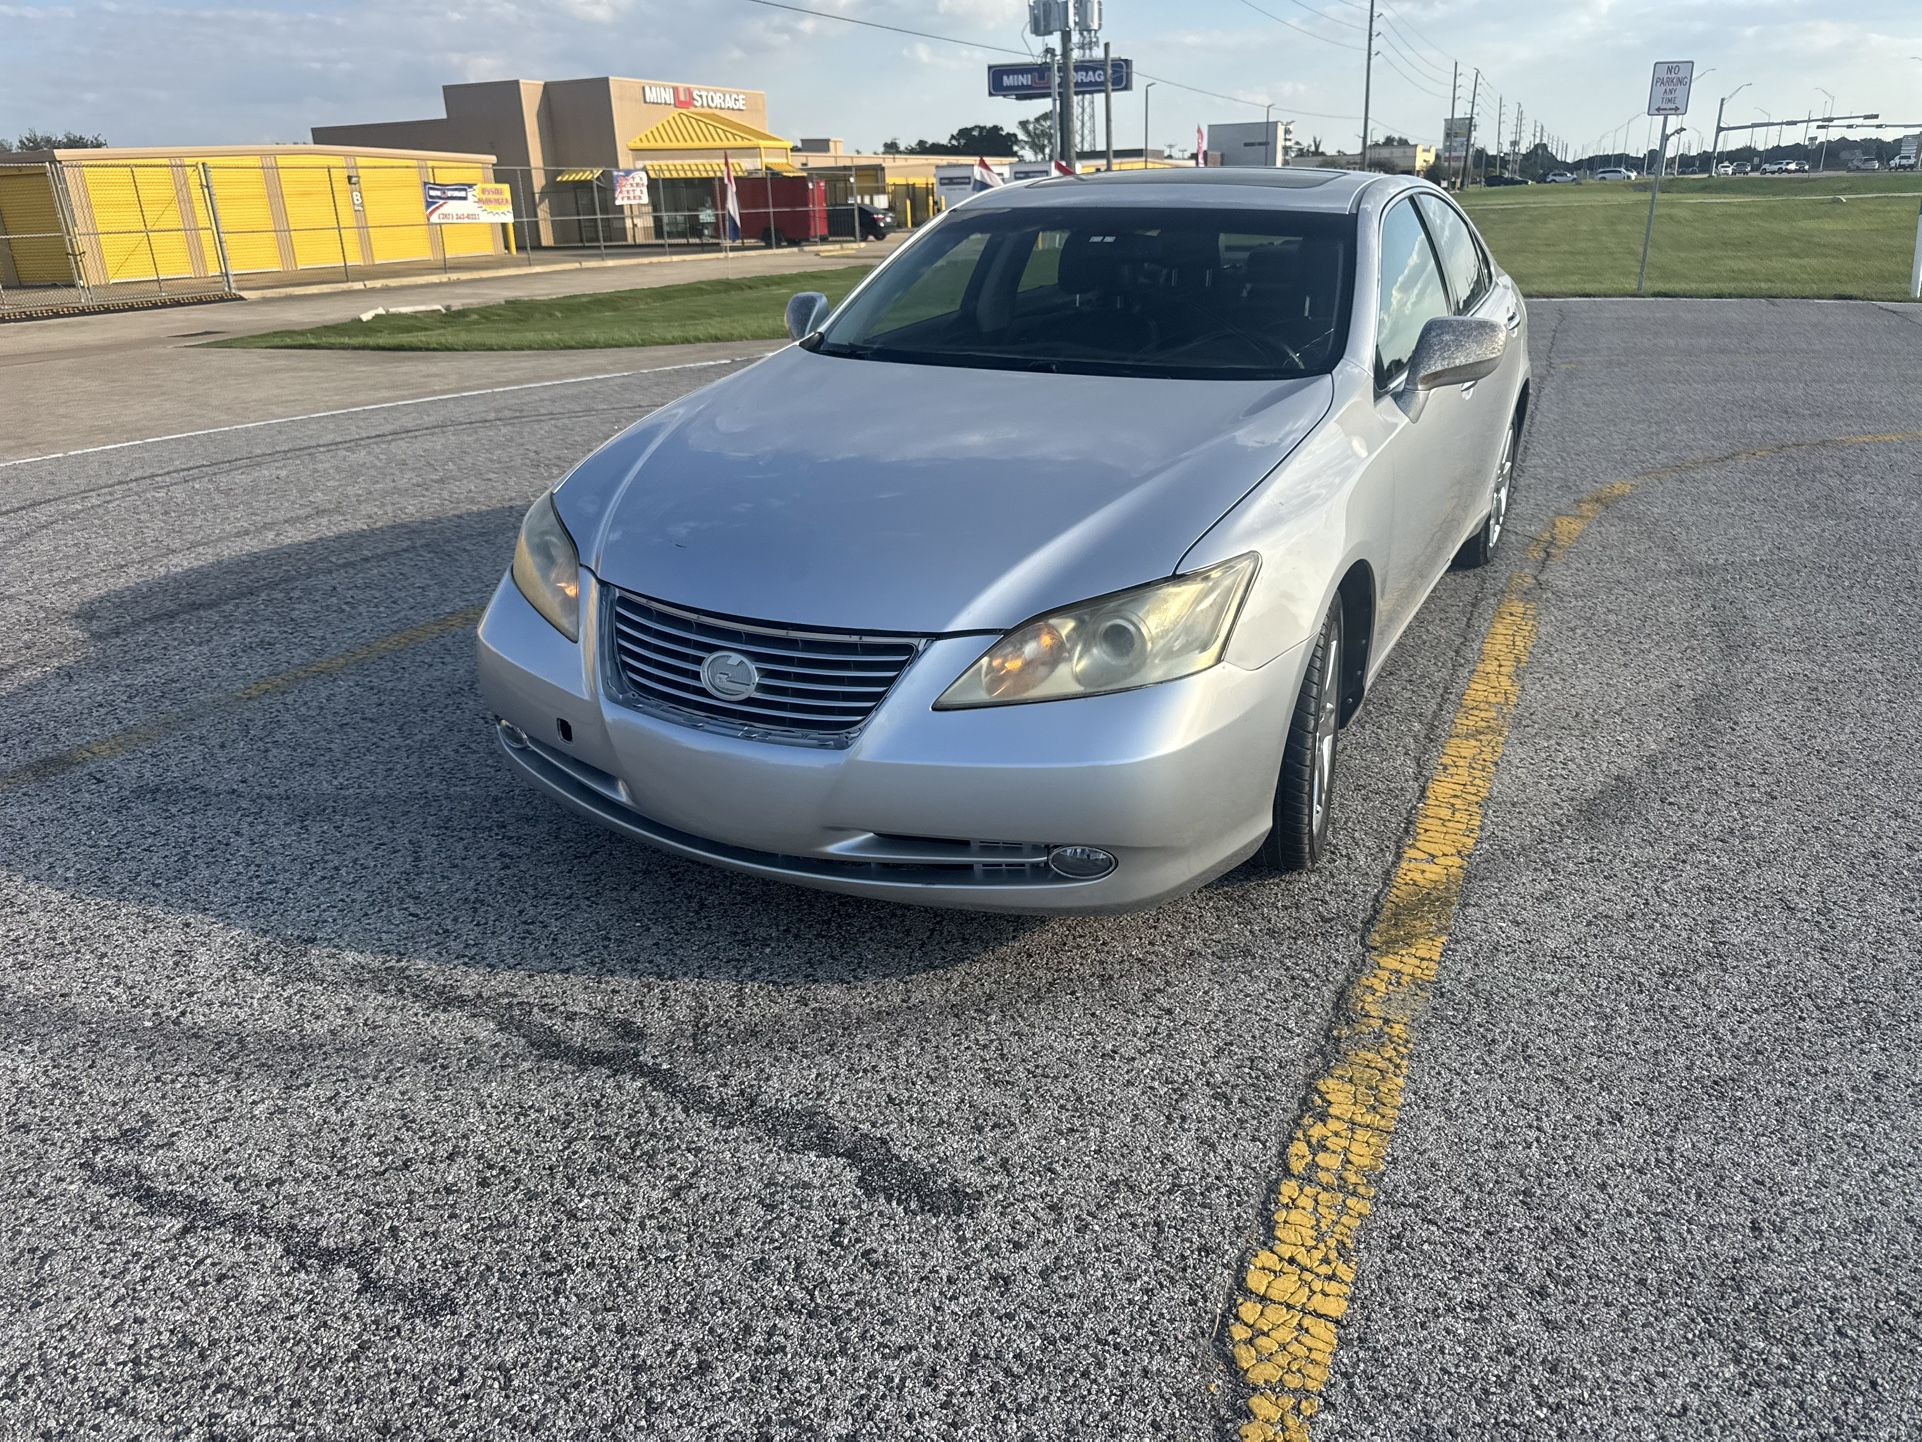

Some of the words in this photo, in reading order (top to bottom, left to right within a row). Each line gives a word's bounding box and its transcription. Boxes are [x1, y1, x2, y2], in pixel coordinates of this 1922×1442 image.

[1666, 65, 1680, 75] NO
[1003, 73, 1032, 87] MINI
[1655, 76, 1688, 87] PARKING
[1663, 88, 1677, 96] ANY
[643, 85, 675, 105] MINI
[674, 86, 693, 109] U
[692, 89, 746, 111] STORAGE
[1661, 96, 1677, 105] TIME
[352, 191, 362, 205] B
